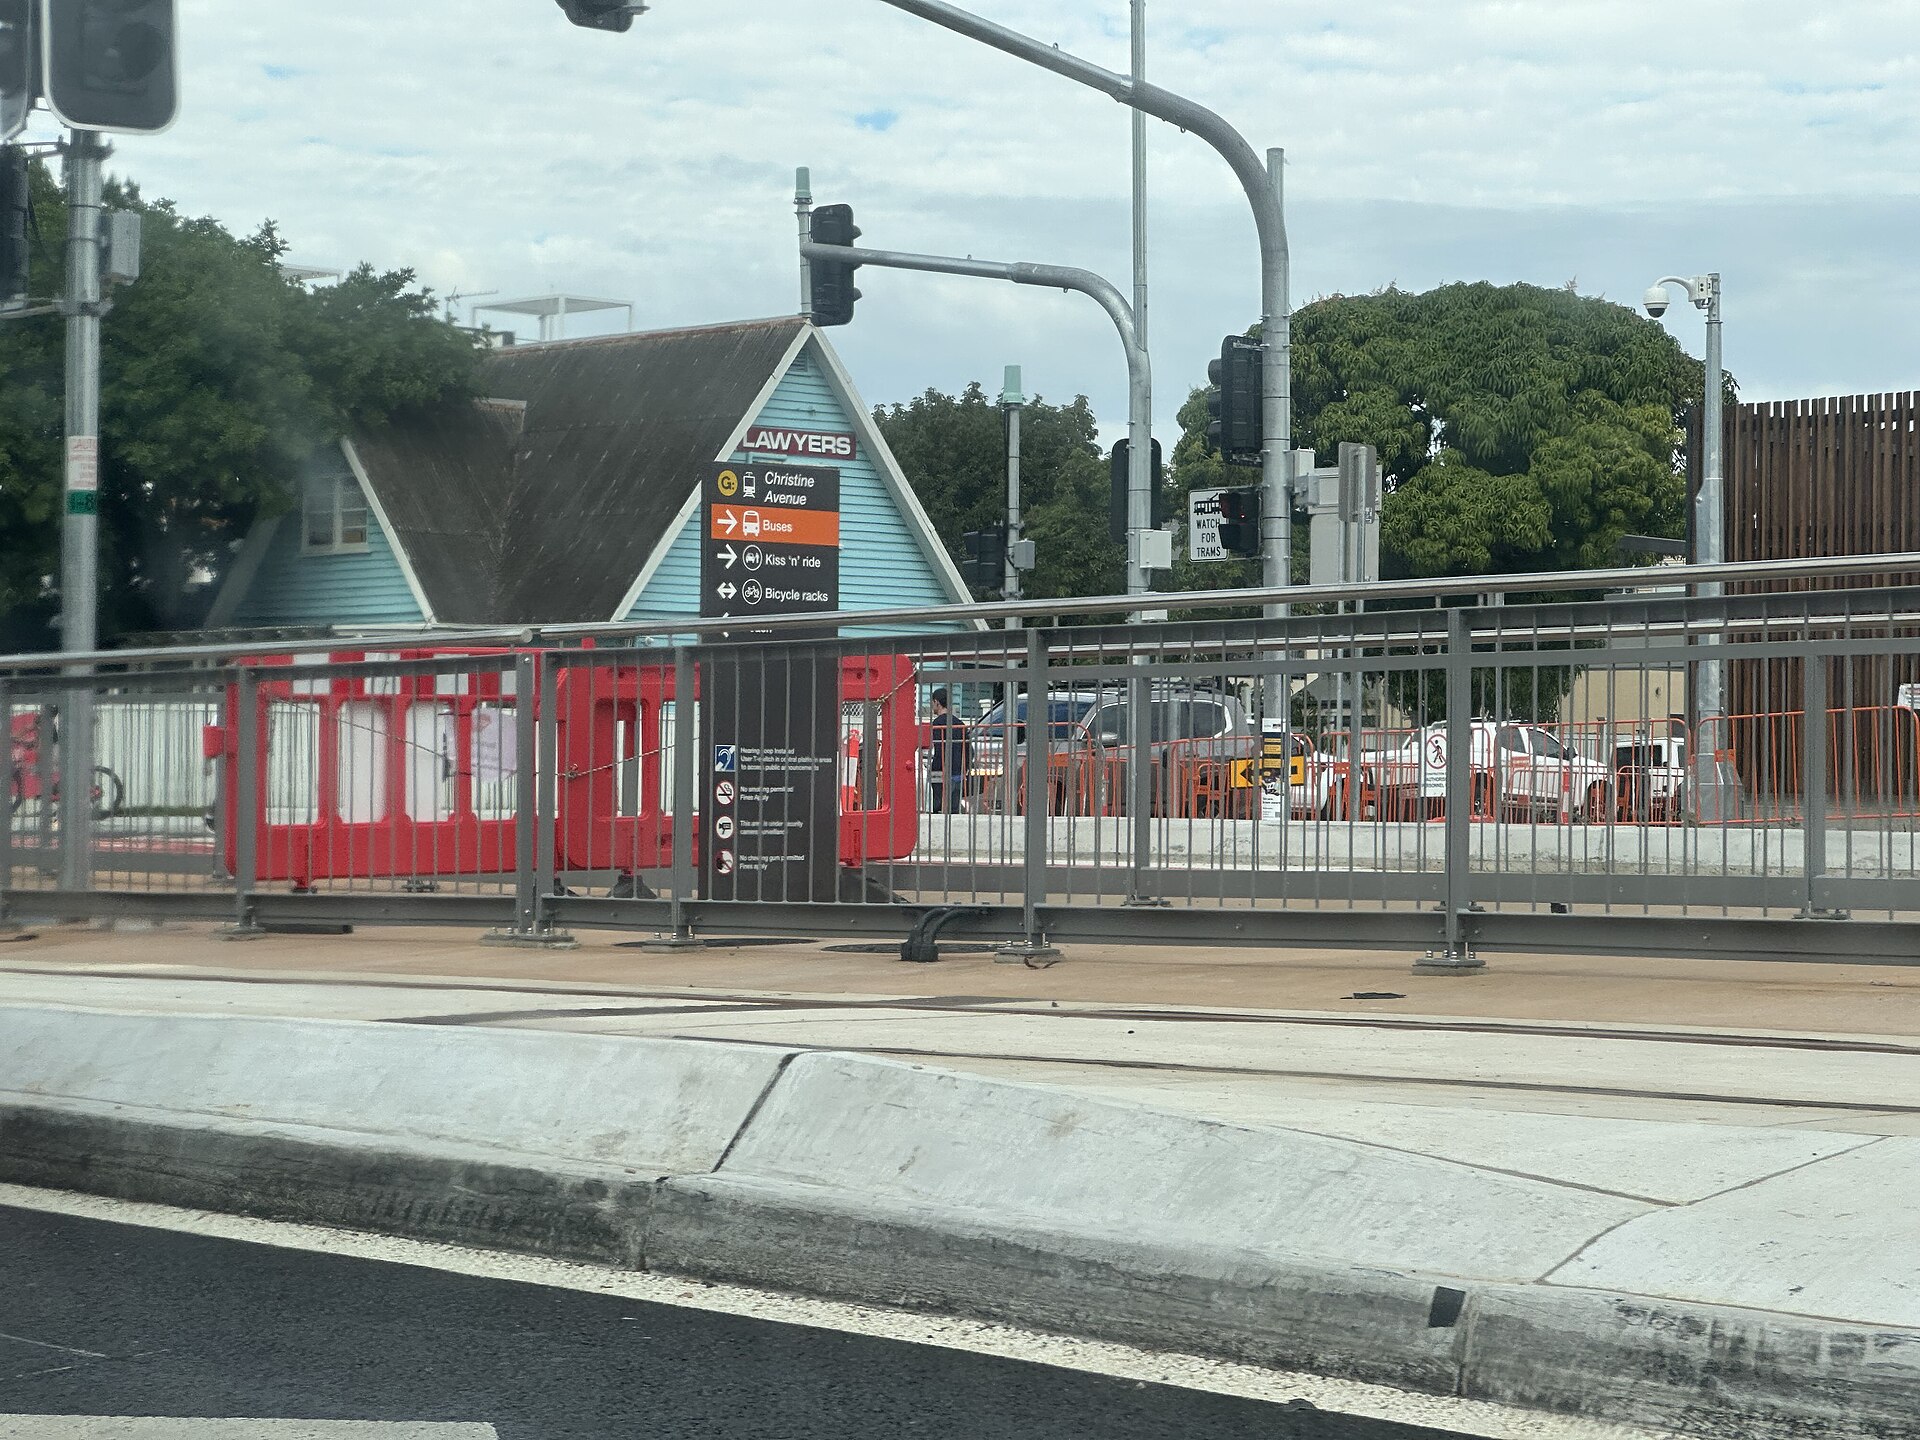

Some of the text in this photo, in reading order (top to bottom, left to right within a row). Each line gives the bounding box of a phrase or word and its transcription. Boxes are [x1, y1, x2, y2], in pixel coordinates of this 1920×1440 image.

[743, 430, 851, 454] LAWYERS
[764, 471, 815, 488] Christine
[764, 490, 807, 506] Avenue
[762, 519, 793, 533] Buses
[1196, 518, 1220, 529] WATCH
[1201, 533, 1216, 543] FOR
[1196, 546, 1221, 557] TRAMS
[765, 553, 786, 567] Kiss
[802, 556, 821, 569] ride
[765, 587, 829, 603] Bicycle racks
